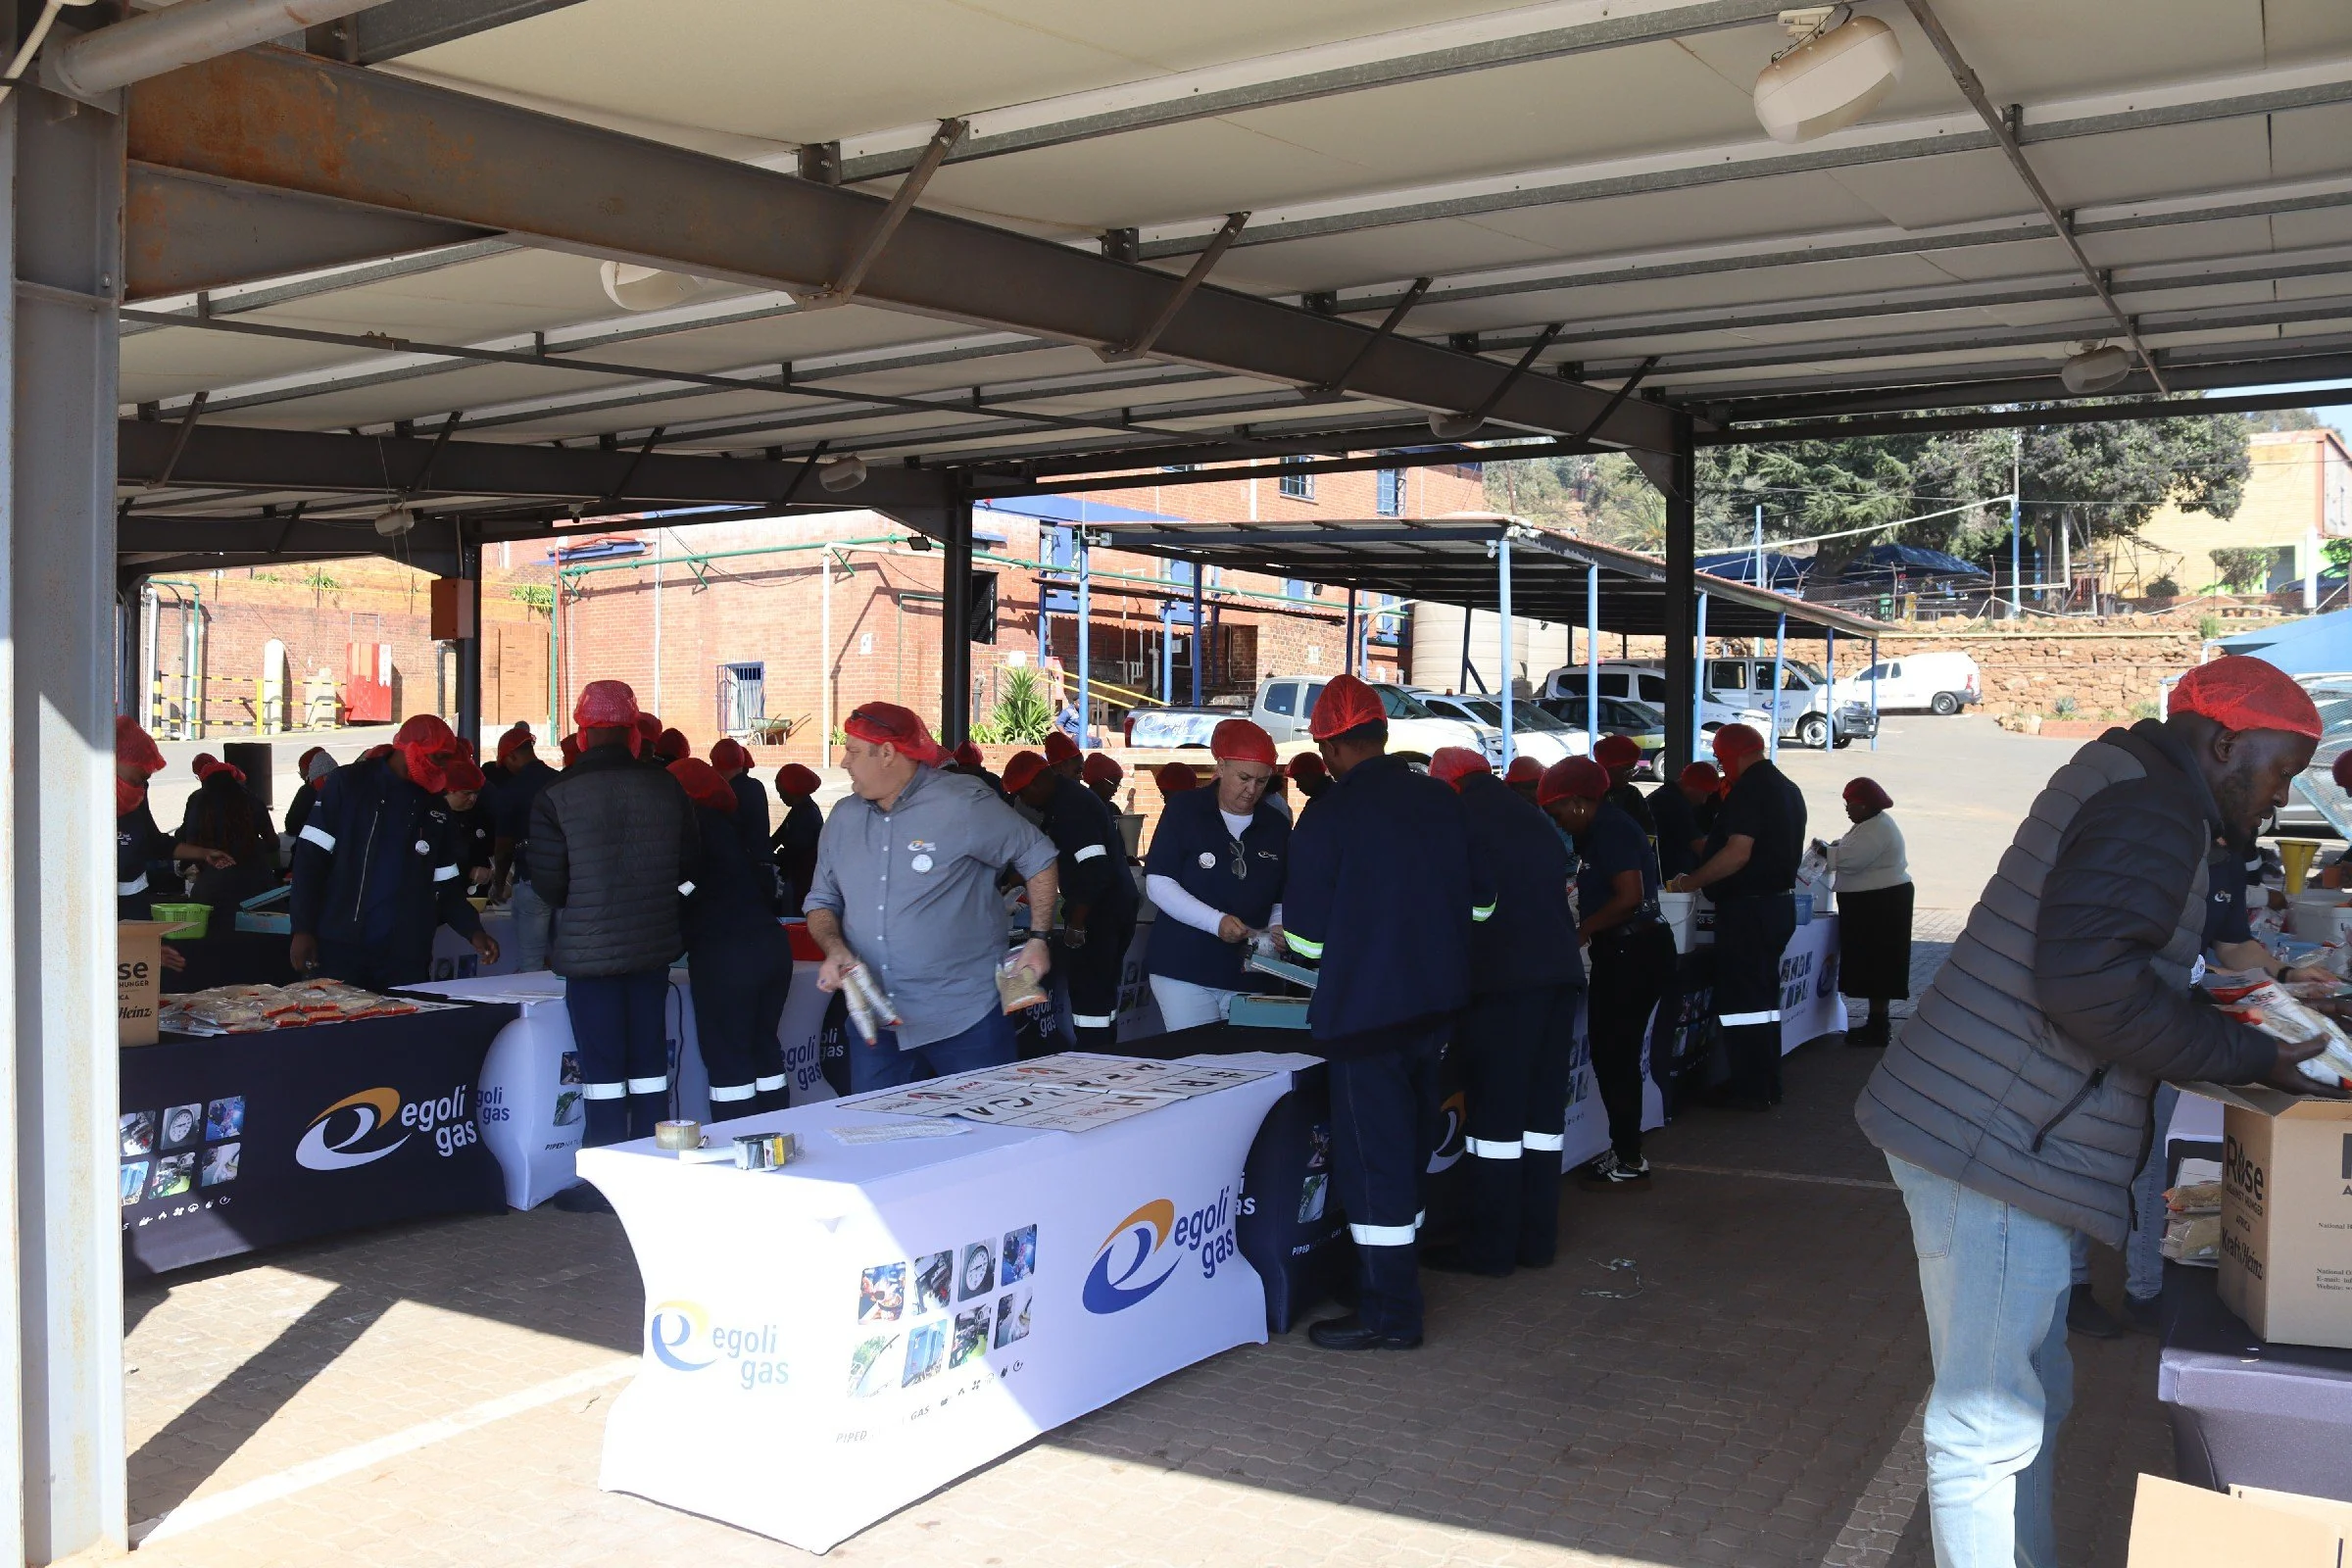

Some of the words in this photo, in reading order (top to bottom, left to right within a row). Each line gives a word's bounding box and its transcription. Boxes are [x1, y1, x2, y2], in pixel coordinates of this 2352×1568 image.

[118, 962, 149, 980] se
[119, 1005, 152, 1019] Heinz
[797, 1061, 822, 1092] gas
[401, 1084, 467, 1132] egoli
[476, 1086, 503, 1107] goli
[482, 1105, 510, 1126] gas
[435, 1119, 478, 1157] gas
[545, 1142, 564, 1151] PIPED
[1174, 1185, 1231, 1250] egoli
[1236, 1197, 1256, 1216] as
[1201, 1228, 1235, 1279] gas
[1292, 1244, 1310, 1256] PIPED
[712, 1324, 777, 1358] egoli
[741, 1359, 789, 1390] gas
[836, 1430, 868, 1444] PIPED
[910, 1405, 930, 1421] GAS
